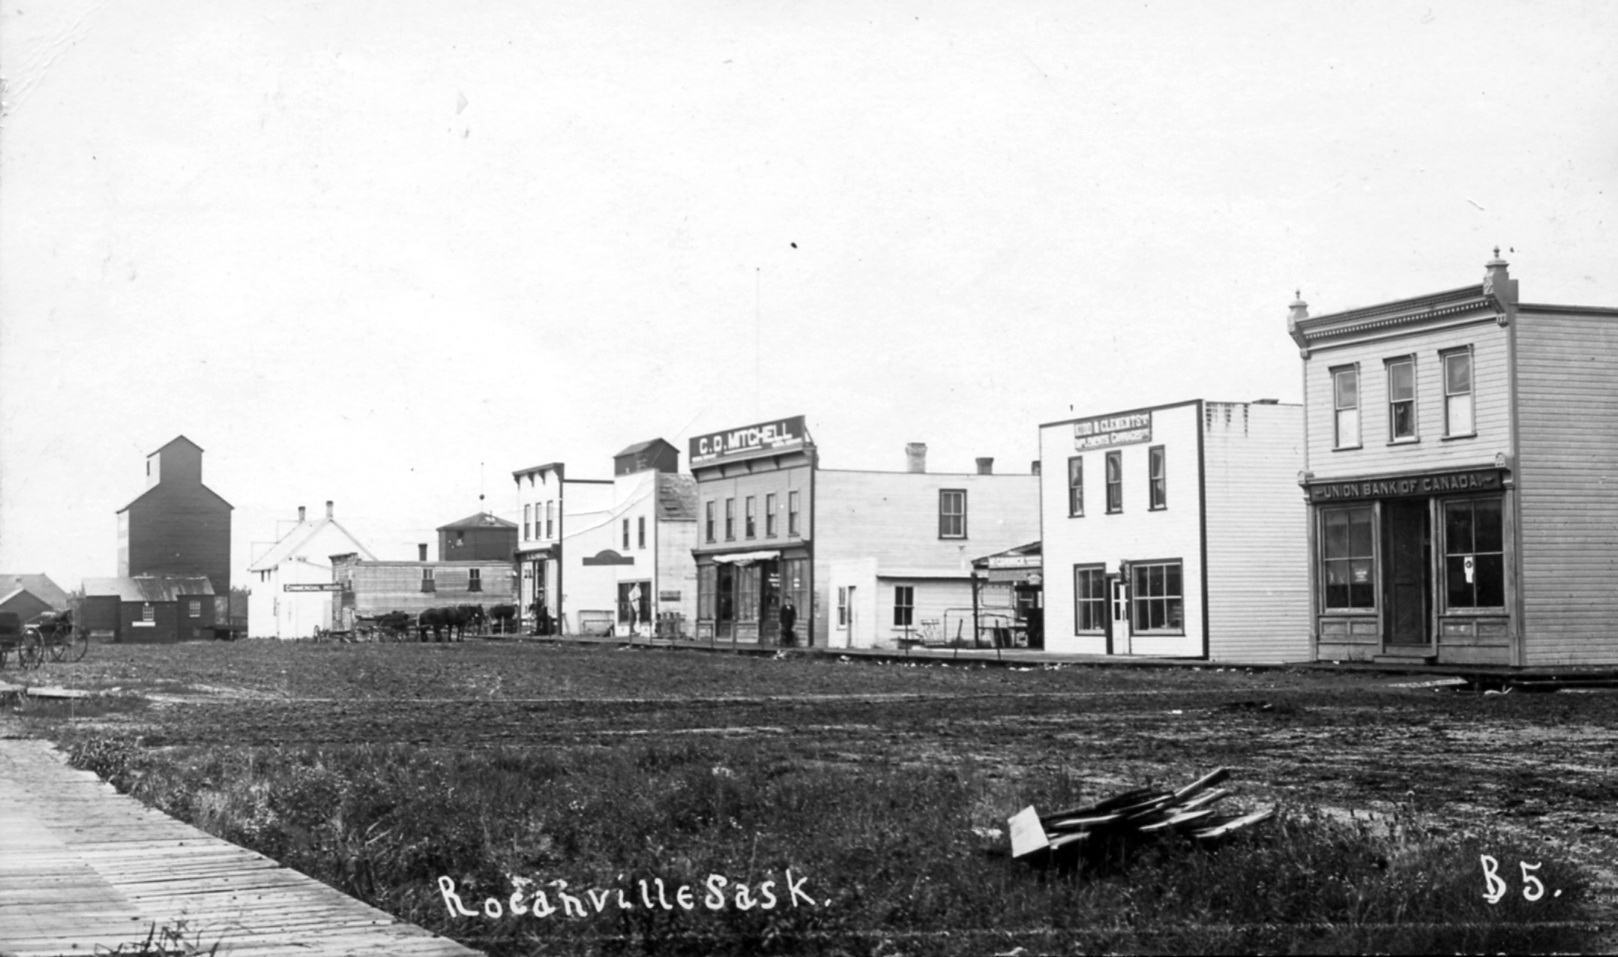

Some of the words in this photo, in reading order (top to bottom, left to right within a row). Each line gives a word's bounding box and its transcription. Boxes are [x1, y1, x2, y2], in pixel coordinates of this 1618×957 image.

[1322, 483, 1359, 498] UNION
[1363, 480, 1397, 496] BANK
[1402, 479, 1417, 493] OF
